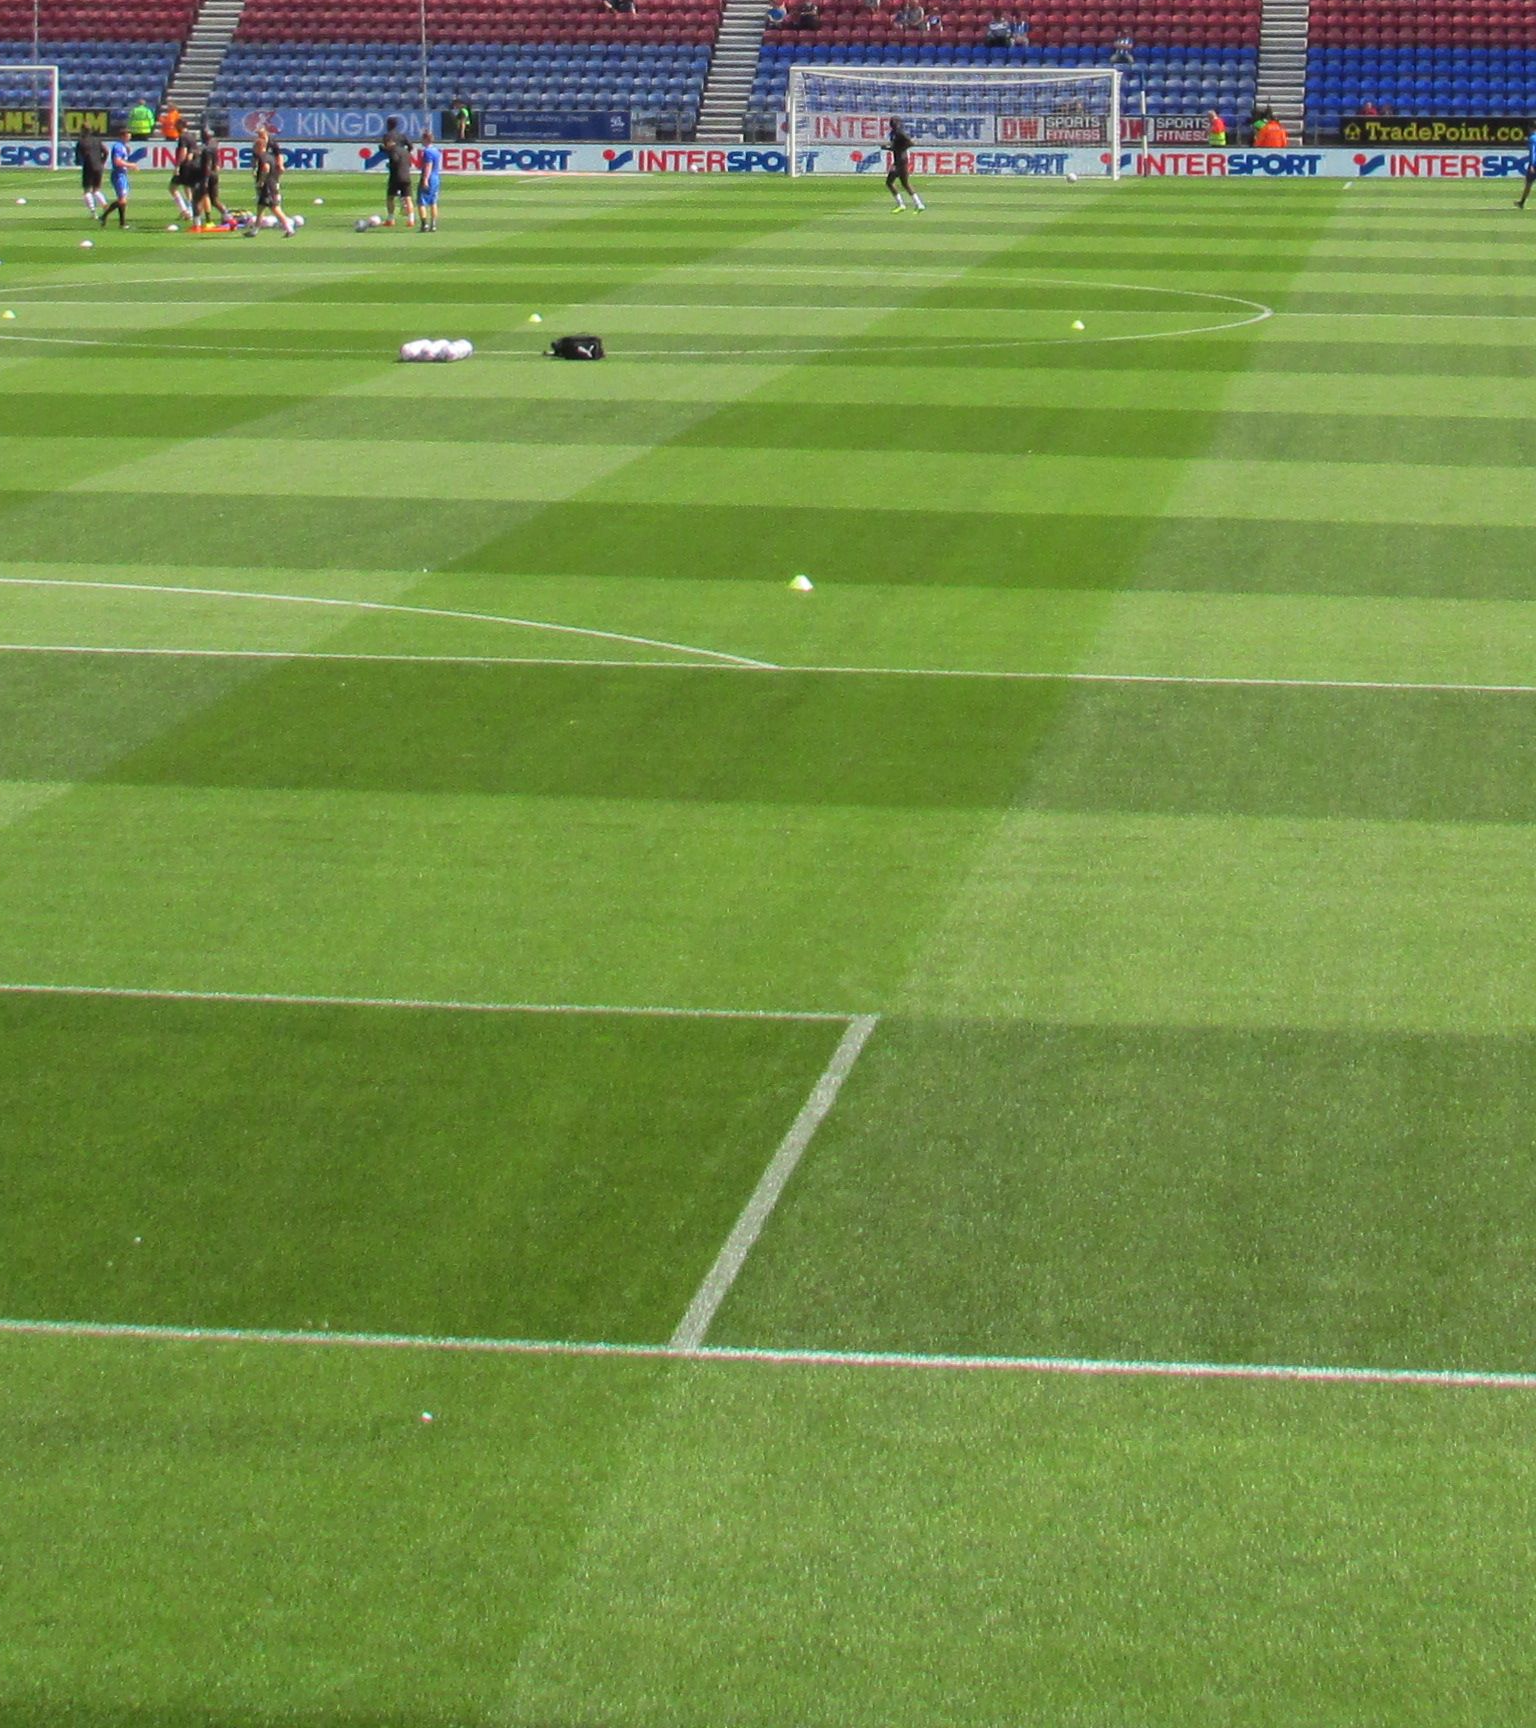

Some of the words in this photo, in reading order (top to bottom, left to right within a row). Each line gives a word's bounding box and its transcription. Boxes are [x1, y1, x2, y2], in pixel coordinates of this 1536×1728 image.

[296, 113, 434, 137] KINGDOM
[1003, 118, 1039, 140] DW
[1046, 117, 1101, 128] SPORTS
[1156, 117, 1211, 129] SPORTS
[1046, 129, 1101, 141] FITNESS
[1136, 153, 1322, 176] INTERSPORT
